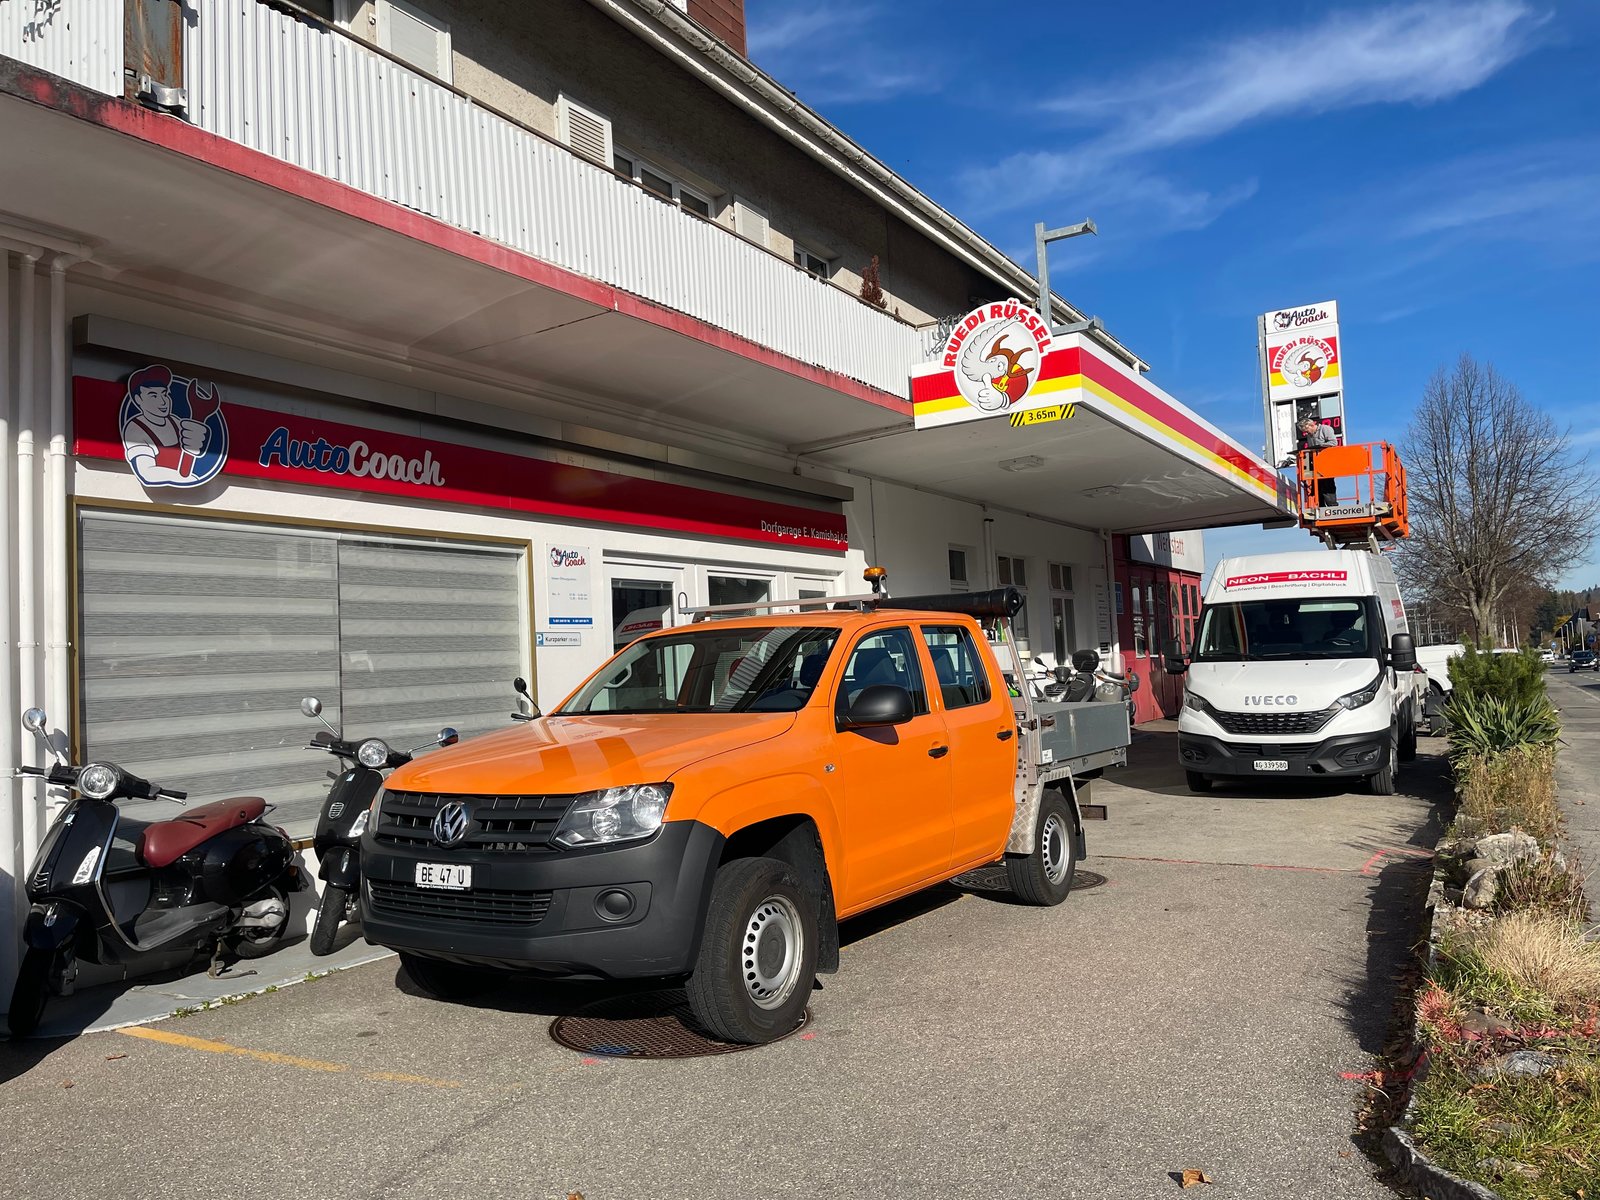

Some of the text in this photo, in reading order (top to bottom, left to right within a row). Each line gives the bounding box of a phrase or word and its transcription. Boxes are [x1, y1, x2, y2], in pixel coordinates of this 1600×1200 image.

[1290, 307, 1316, 321] Auto
[1295, 310, 1329, 326] Coach
[944, 309, 986, 367] RUEDI
[990, 300, 1052, 354] RÜSSEL
[1275, 335, 1335, 367] RUEDI RÜSSEL
[1028, 409, 1057, 421] 3.65m
[1332, 507, 1365, 516] snorkel
[760, 520, 802, 538] Dorfgarage
[803, 526, 810, 537] E.
[811, 528, 840, 544] Kamishaj
[562, 550, 579, 558] Auto
[564, 556, 586, 567] Coach
[1229, 575, 1269, 585] NEON
[545, 635, 568, 643] Kurzparker
[1244, 695, 1298, 705] IVECO
[421, 866, 465, 885] BE 47 U
